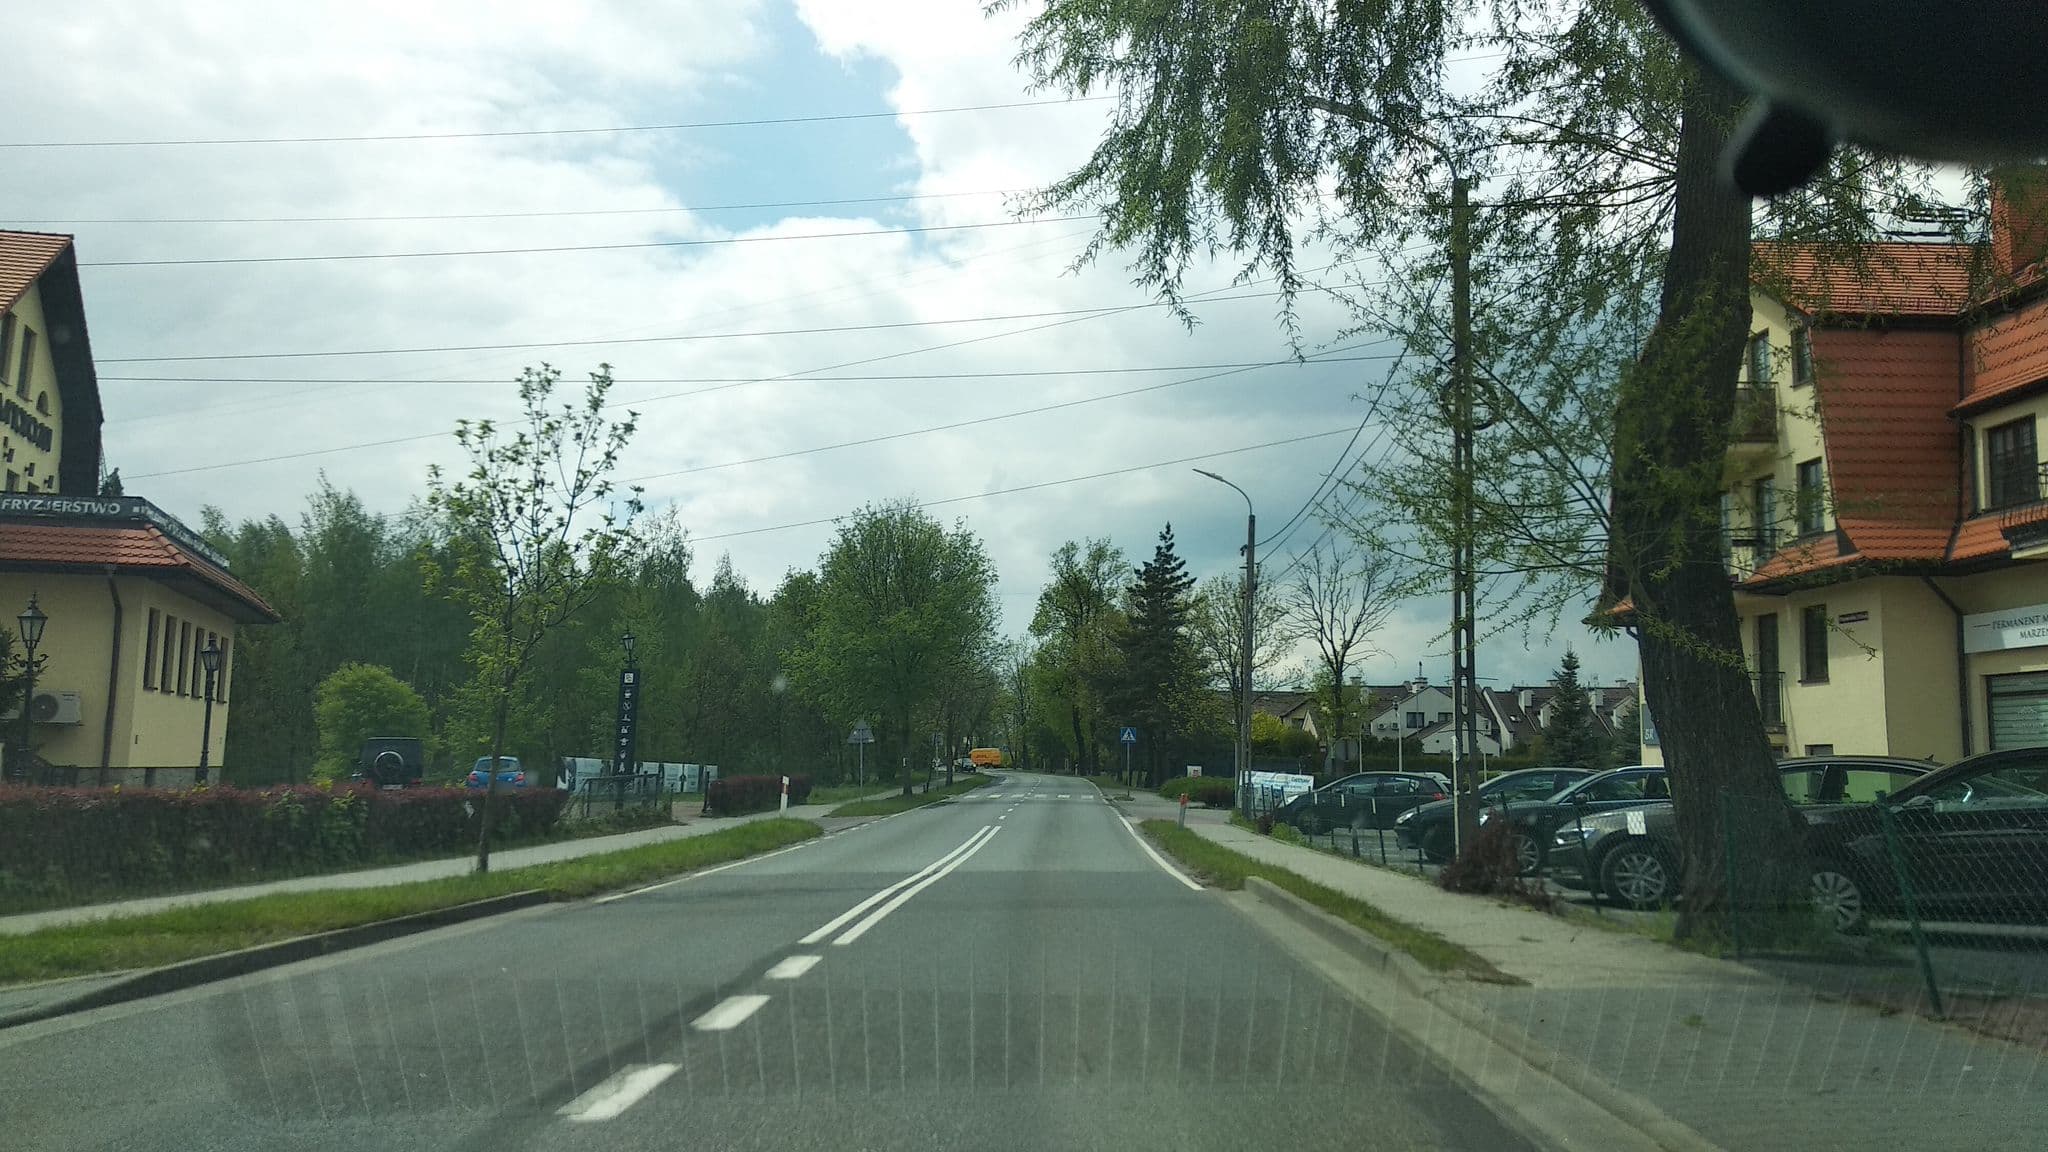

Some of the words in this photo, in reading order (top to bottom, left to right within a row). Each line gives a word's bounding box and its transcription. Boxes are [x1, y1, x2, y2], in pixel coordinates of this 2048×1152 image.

[1, 498, 121, 514] FRYZJERSTWO
[1992, 615, 2041, 630] PERMANENT
[2019, 628, 2048, 640] MARZE
